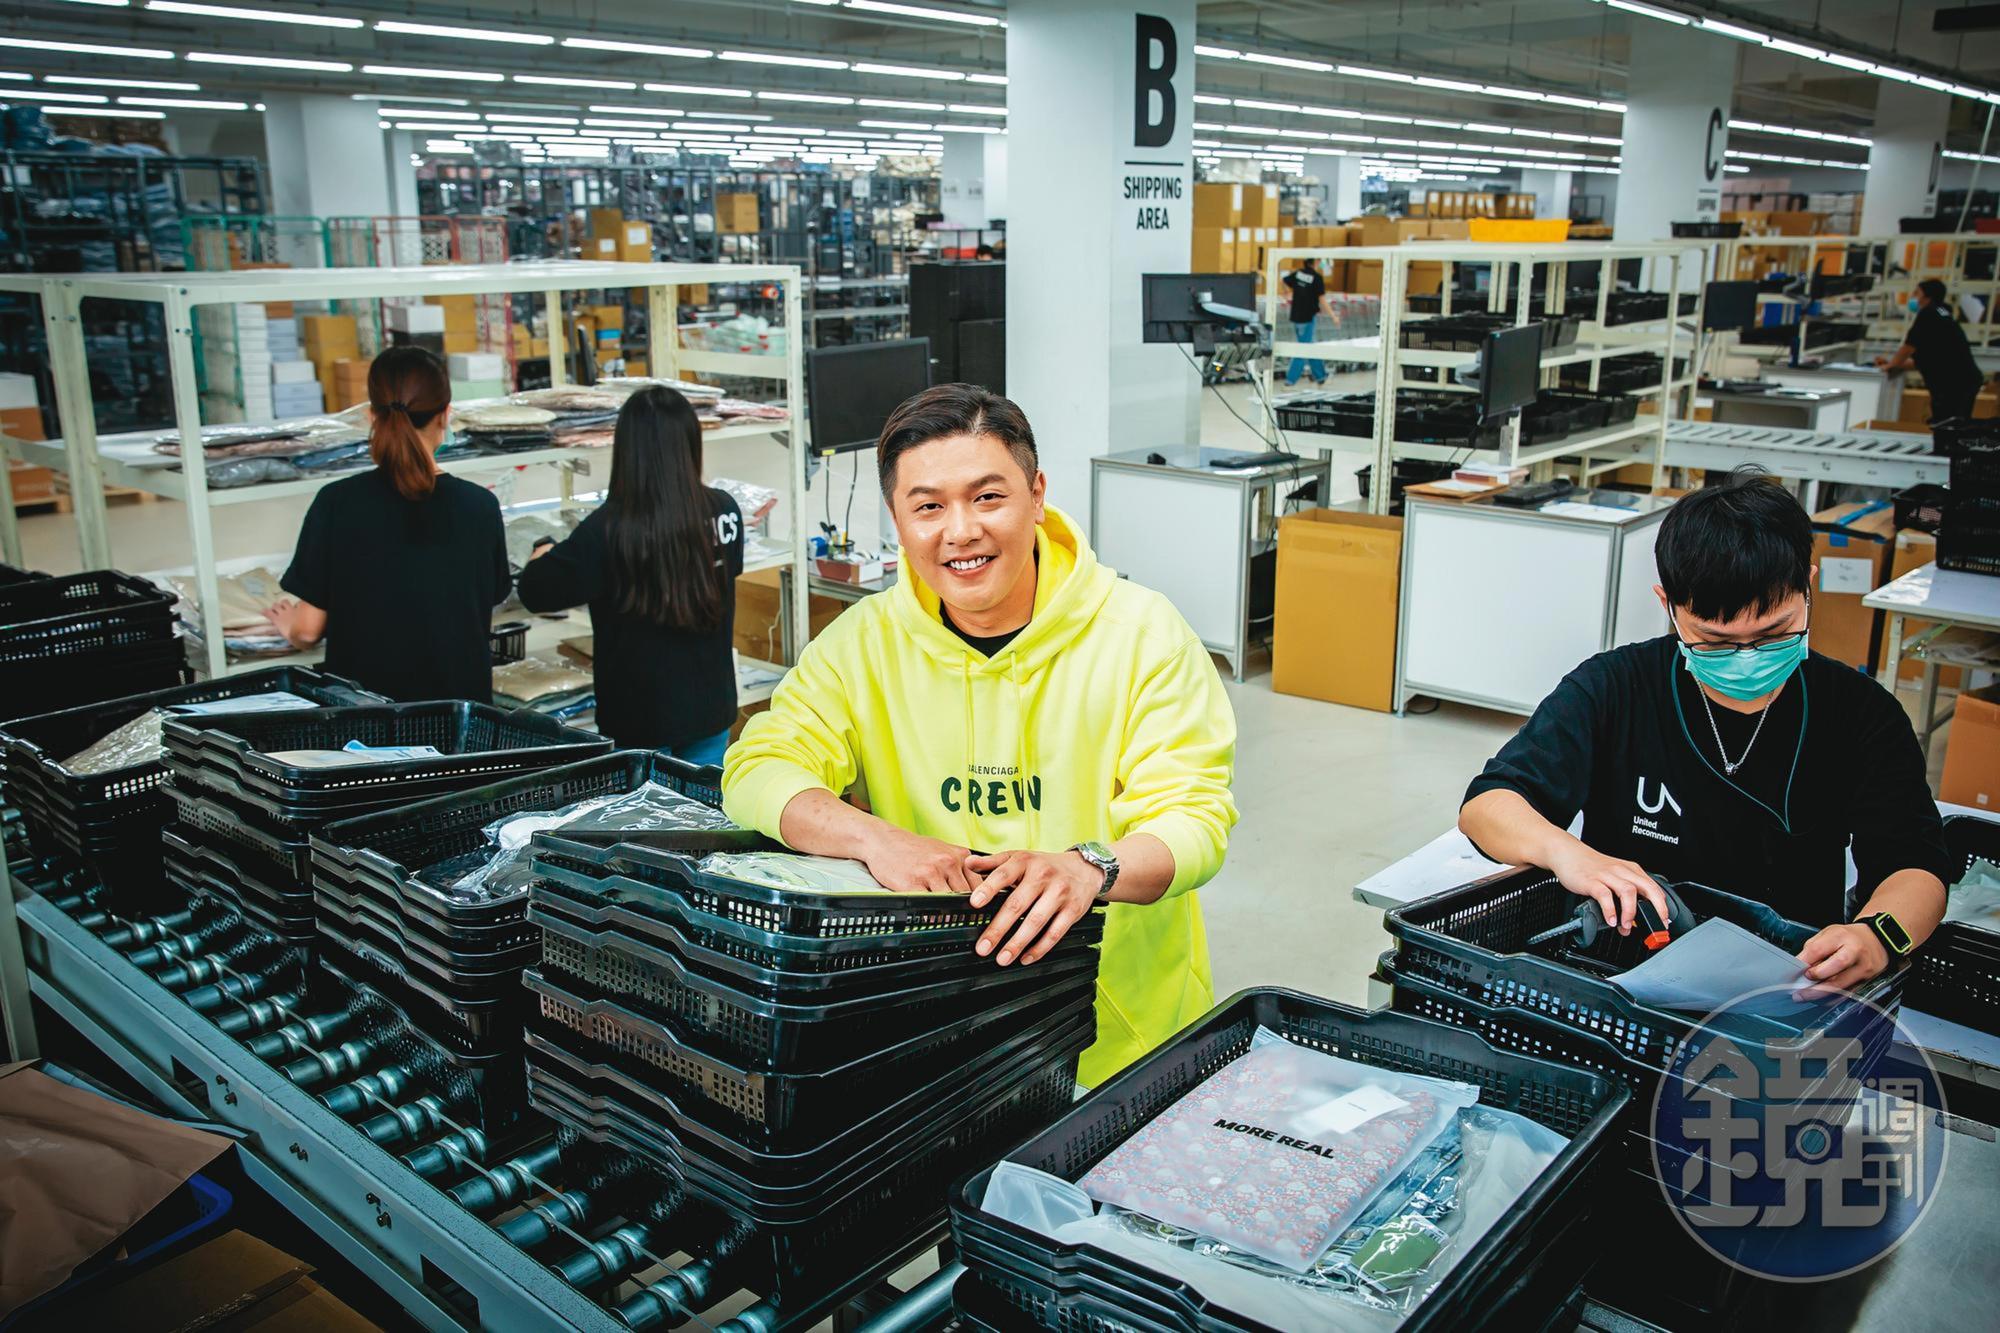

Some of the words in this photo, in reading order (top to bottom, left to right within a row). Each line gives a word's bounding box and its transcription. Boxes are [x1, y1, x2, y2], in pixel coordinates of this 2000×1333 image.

[1134, 13, 1177, 147] B
[1704, 107, 1722, 182] C
[1124, 176, 1182, 200] SHIPPING
[1136, 207, 1170, 230] AREA
[941, 775, 1041, 816] CREW
[1631, 824, 1679, 845] Recommend
[1633, 815, 1658, 829] United
[1213, 1118, 1278, 1142] MORE
[1276, 1134, 1334, 1159] REAL
